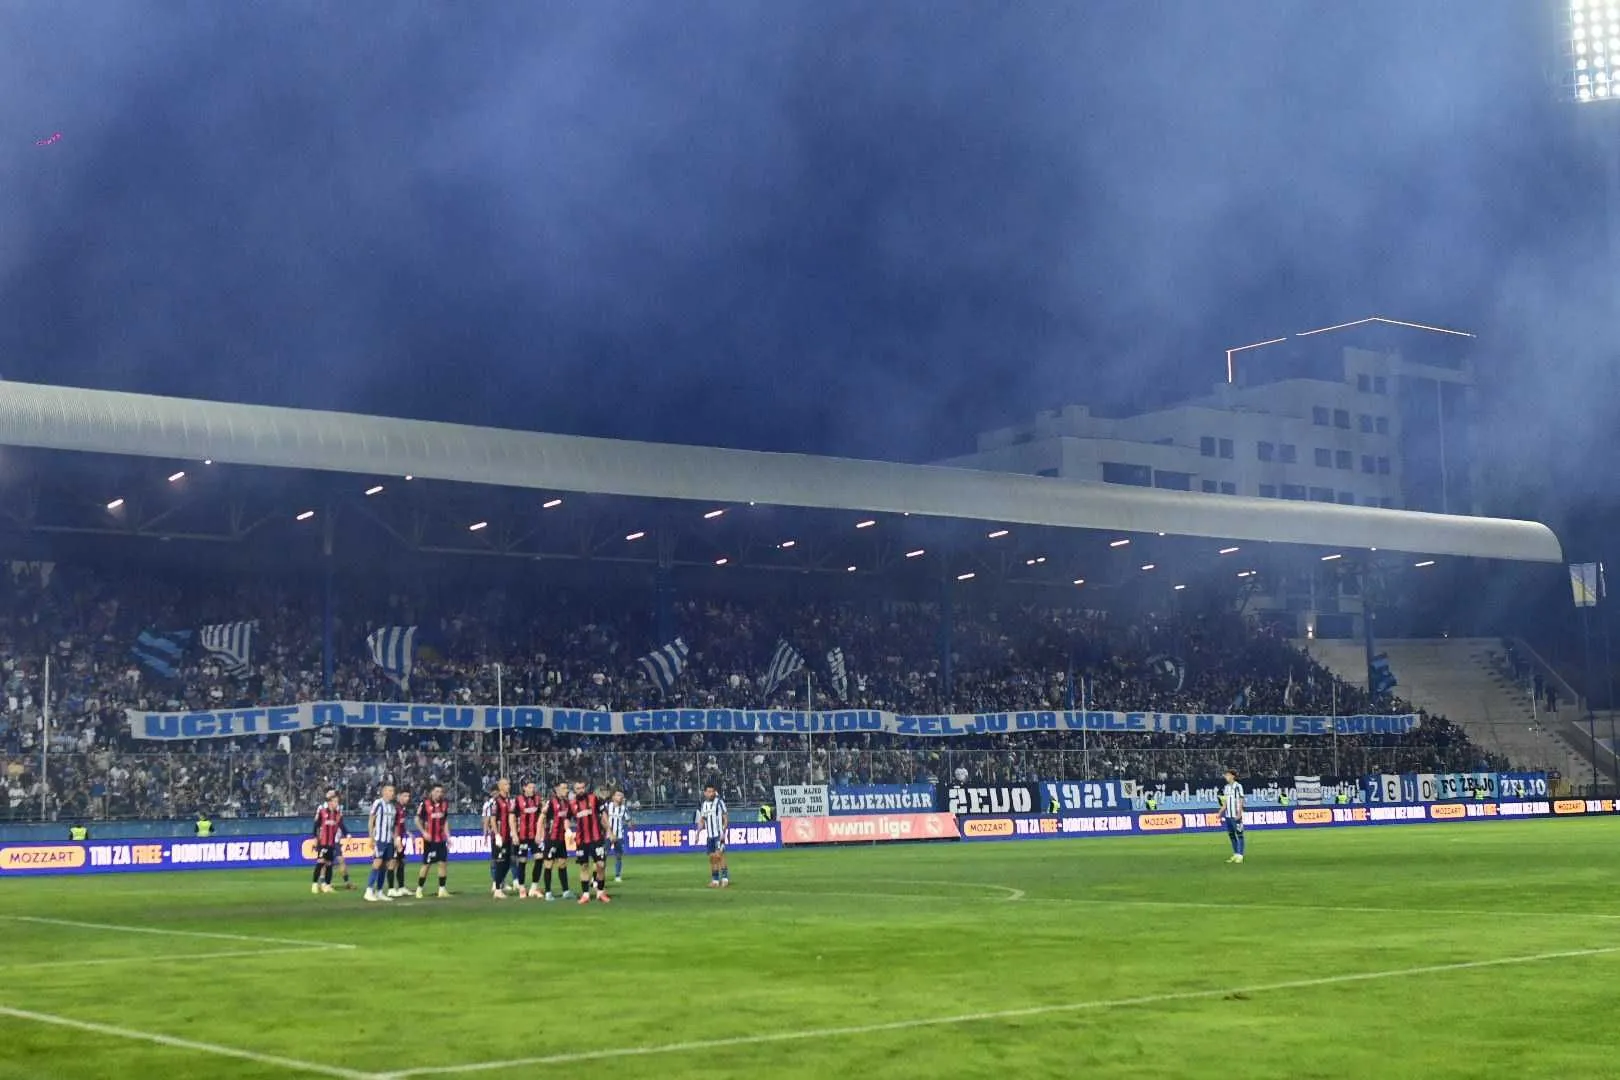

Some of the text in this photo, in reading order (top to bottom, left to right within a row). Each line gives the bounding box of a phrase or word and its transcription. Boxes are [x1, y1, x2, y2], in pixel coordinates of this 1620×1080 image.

[552, 710, 612, 732] NA
[1016, 712, 1057, 730] DA
[1064, 712, 1145, 730] VOLE
[1293, 716, 1328, 734] SE
[1441, 779, 1457, 793] FC
[829, 789, 933, 810] ŽELJEZNIČAR
[1047, 783, 1117, 811] 1921
[879, 816, 912, 838] liga
[970, 823, 1008, 832] MOZZART
[1144, 816, 1177, 825] MOZZART
[9, 851, 75, 864] MOZZART
